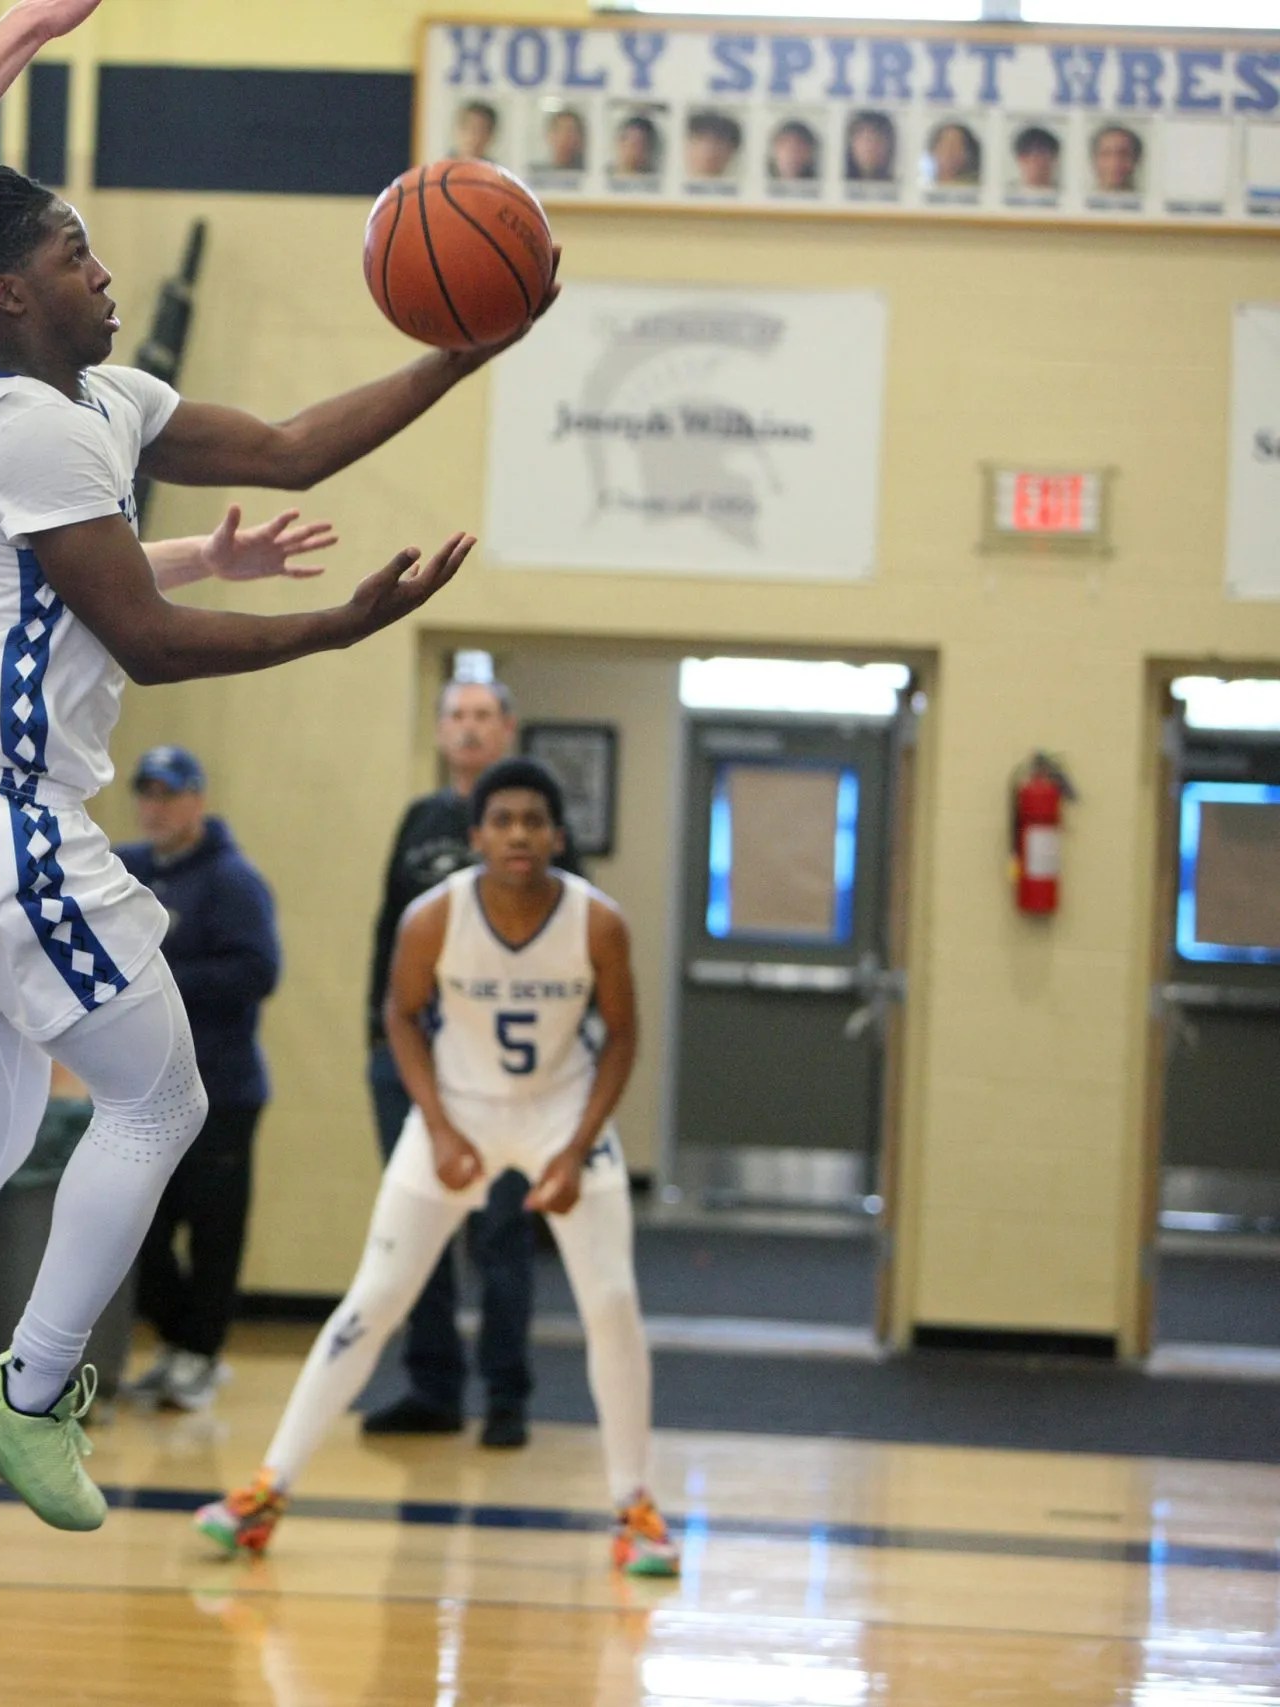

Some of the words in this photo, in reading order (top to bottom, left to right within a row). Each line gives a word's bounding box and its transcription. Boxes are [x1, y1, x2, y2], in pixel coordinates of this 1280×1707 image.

[446, 26, 666, 91] HOLY
[708, 36, 1016, 102] SPIRIT
[1049, 46, 1280, 112] WRES
[1013, 473, 1083, 532] EXIT
[496, 1013, 538, 1075] 5
